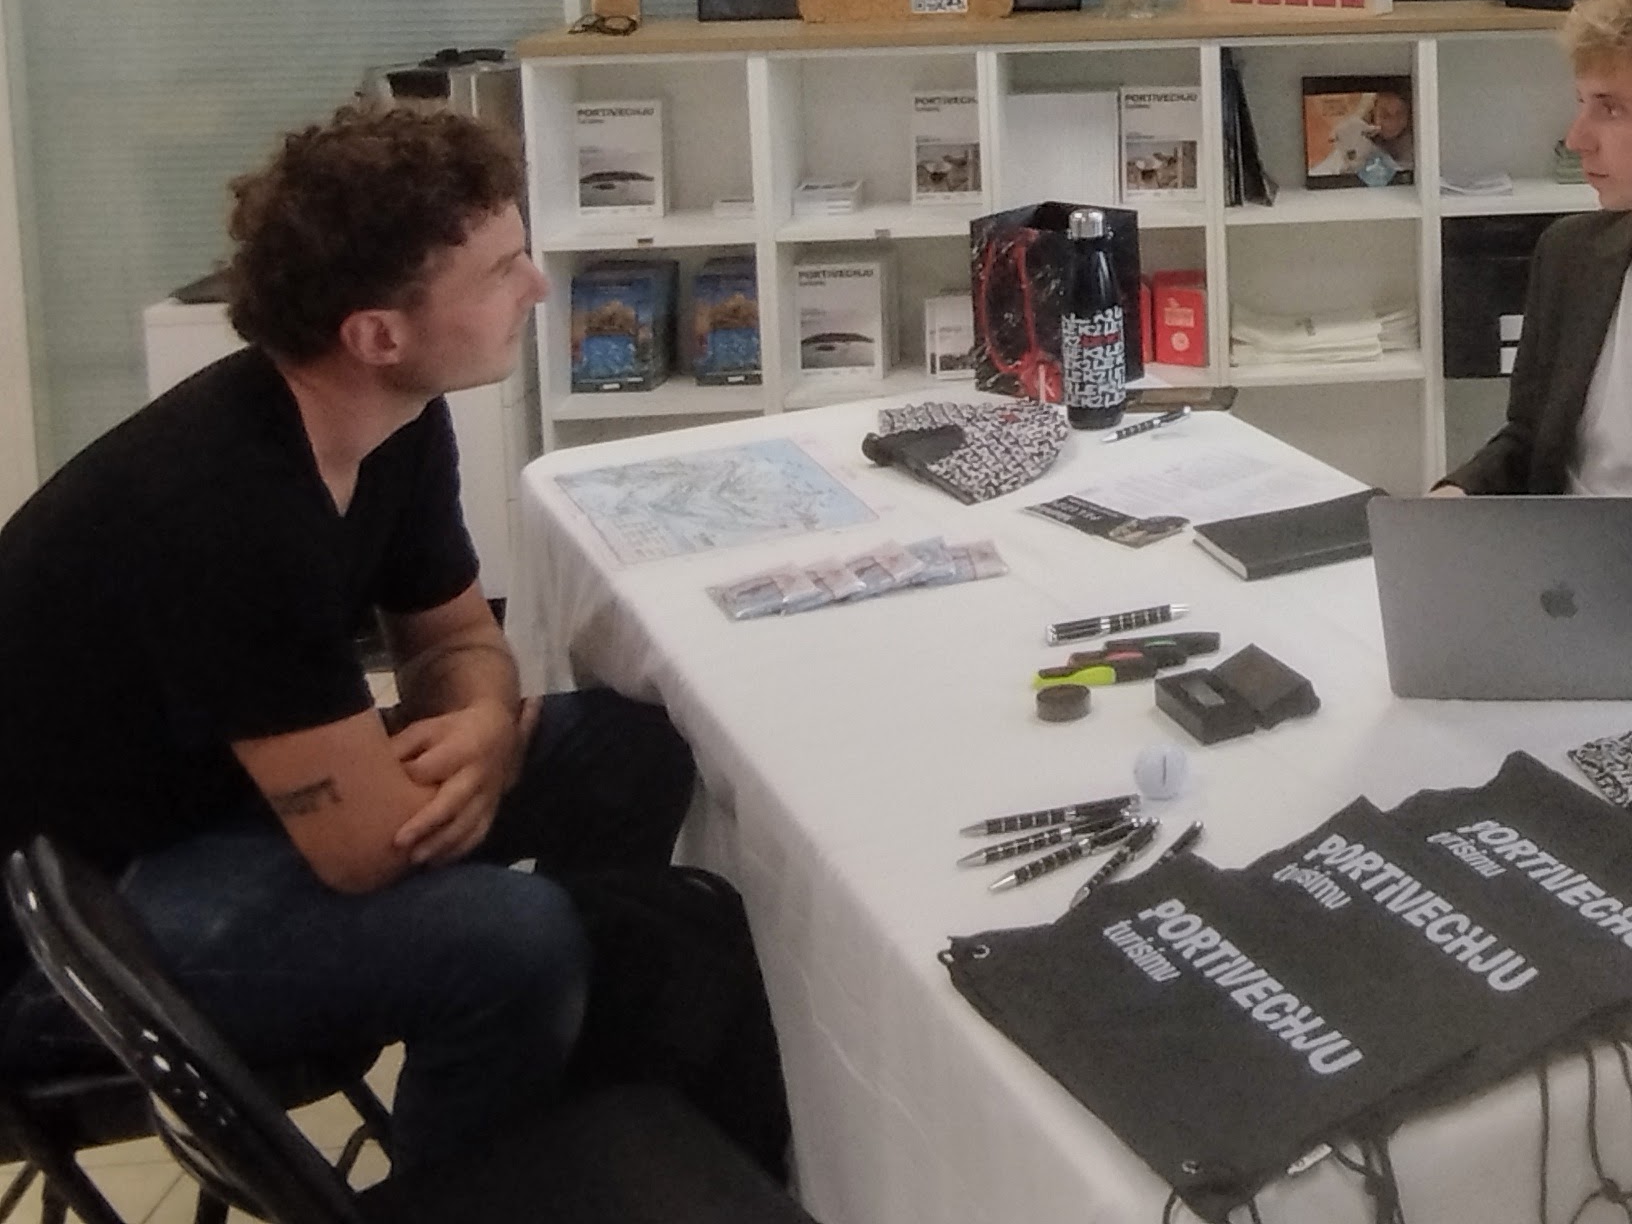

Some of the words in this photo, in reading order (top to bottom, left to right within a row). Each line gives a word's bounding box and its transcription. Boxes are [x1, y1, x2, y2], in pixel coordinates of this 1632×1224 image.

[1102, 918, 1182, 983] turisimu
[1137, 897, 1364, 1075] PORTIVECHJU
[1303, 832, 1539, 992] PORTIVECHJU
